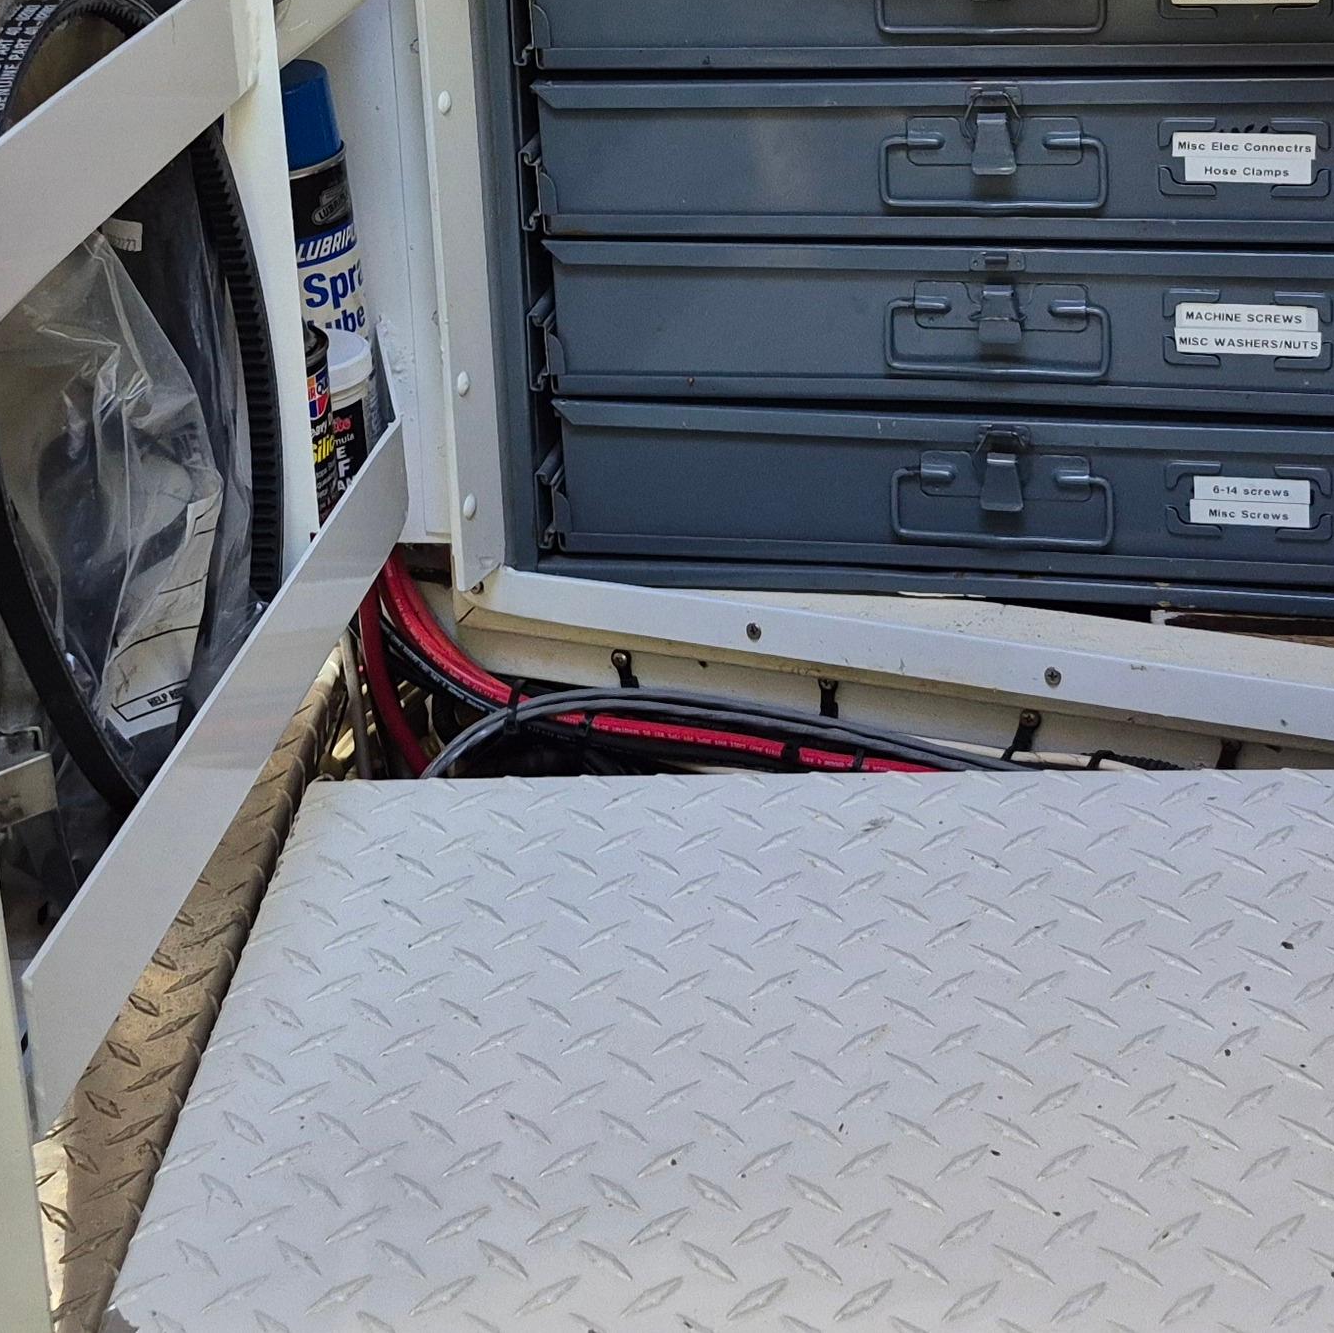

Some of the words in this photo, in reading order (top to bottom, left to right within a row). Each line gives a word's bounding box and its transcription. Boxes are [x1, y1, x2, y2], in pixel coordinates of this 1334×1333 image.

[8, 38, 32, 61] PART
[1177, 141, 1206, 151] Misc
[1211, 141, 1239, 152] Elec
[1244, 142, 1312, 154] Connectrs
[1204, 166, 1237, 176] Hose
[1242, 167, 1290, 178] Clamps
[1185, 311, 1242, 322] MACHINE
[1247, 313, 1302, 324] SCREWS
[1178, 337, 1208, 346] MISC
[1214, 338, 1318, 350] WASHERS/NUTS
[1212, 485, 1238, 494] 6-14
[1243, 487, 1290, 497] screws
[1208, 509, 1236, 518] Misc
[1241, 510, 1289, 520] Screws
[147, 692, 168, 708] HELP
